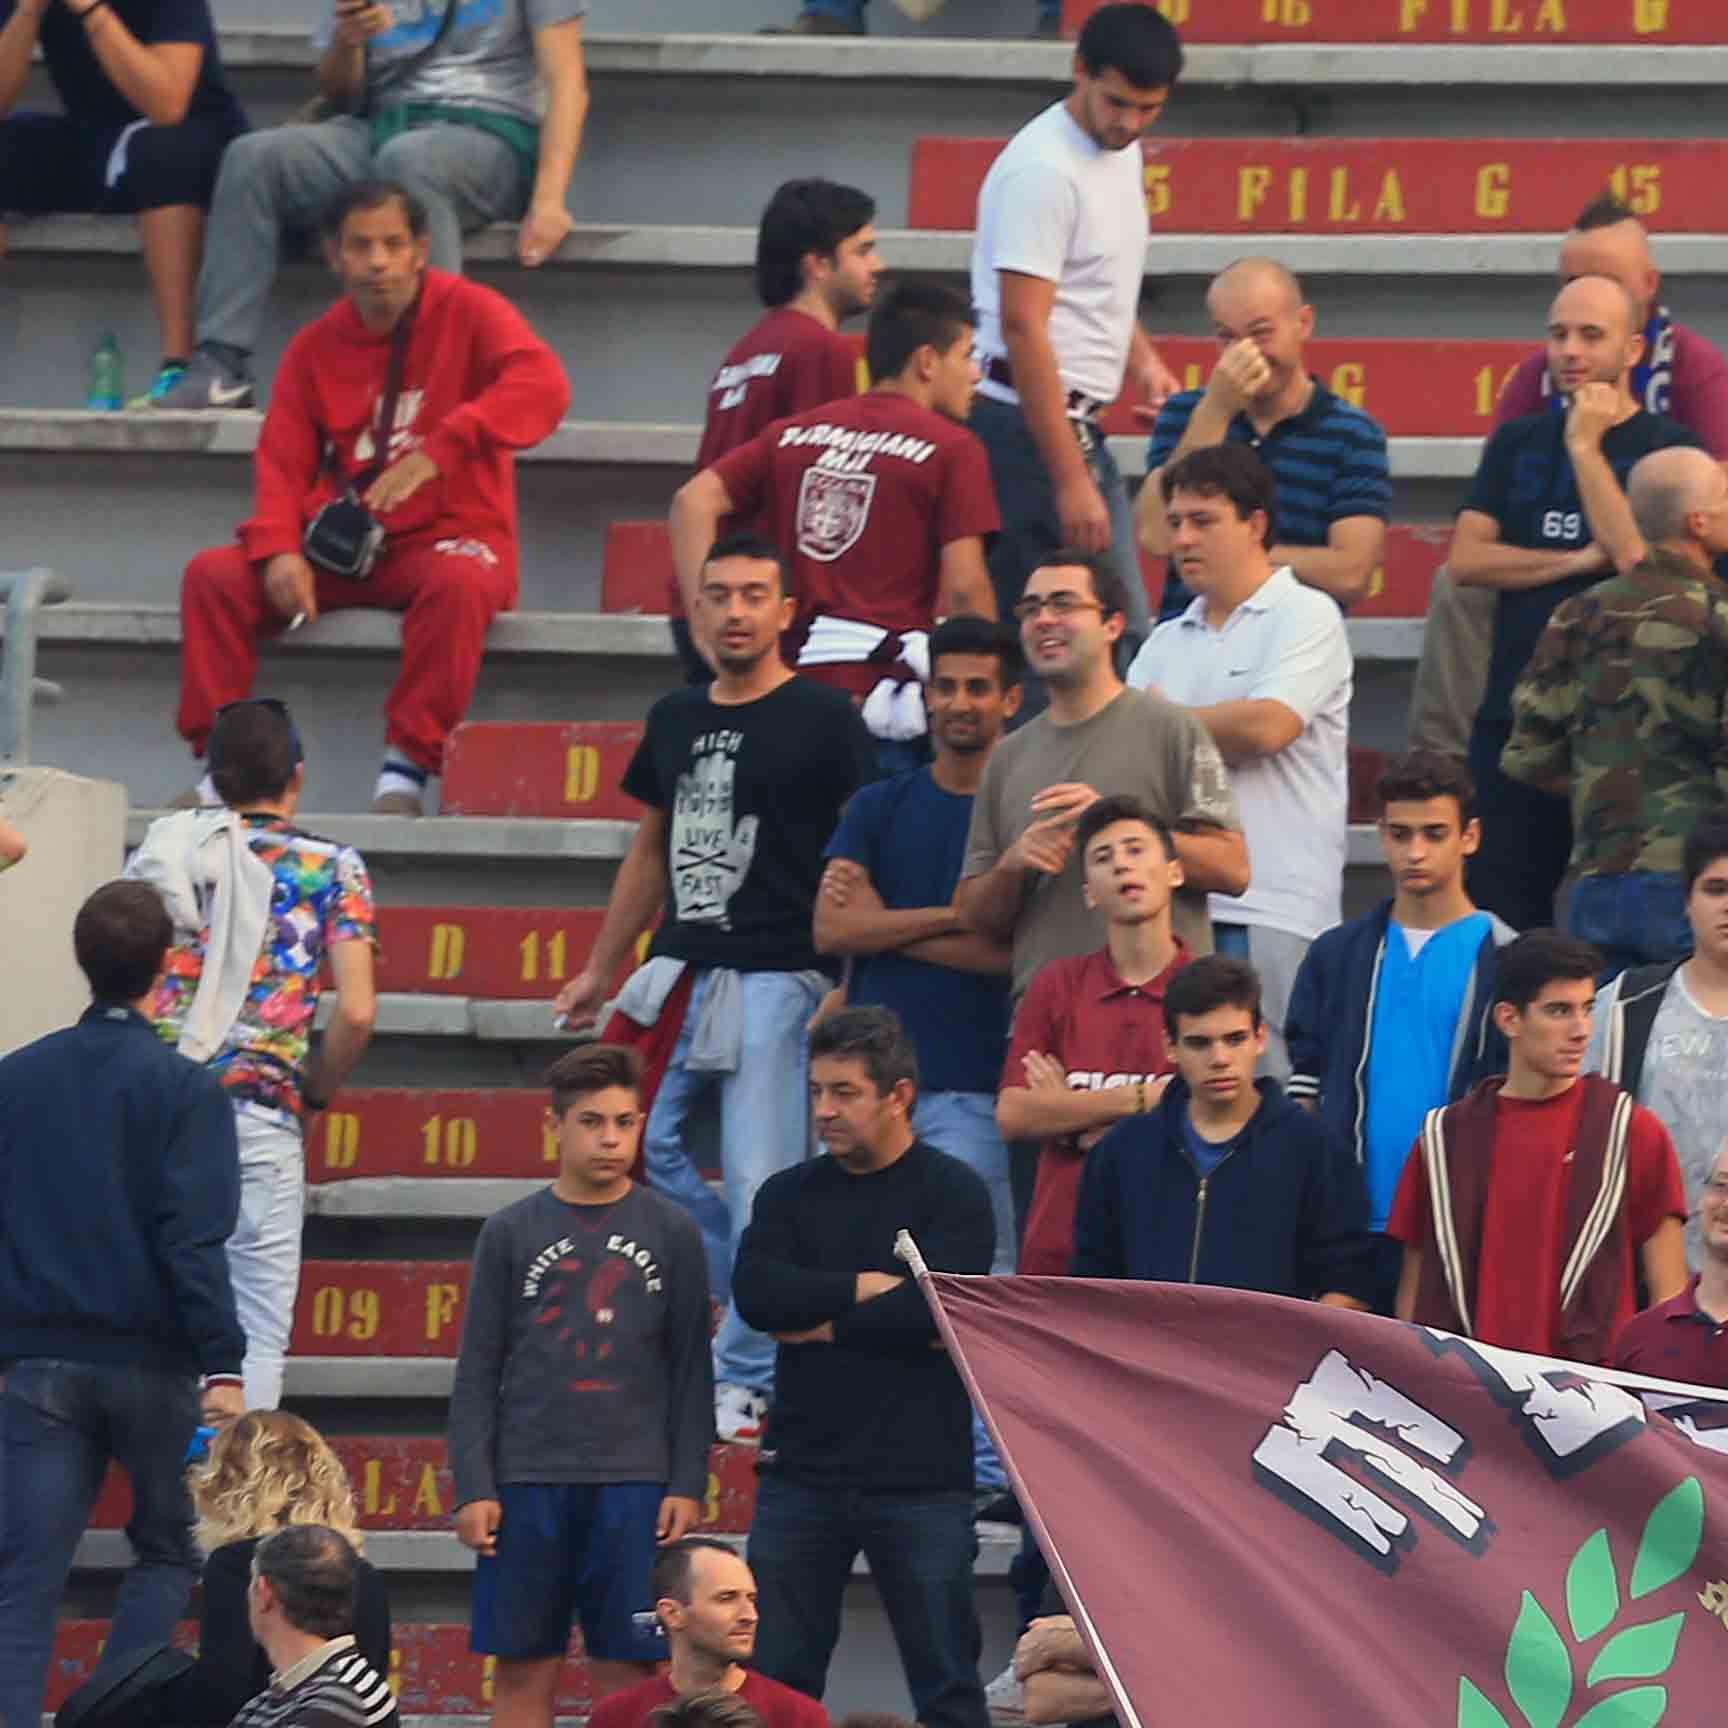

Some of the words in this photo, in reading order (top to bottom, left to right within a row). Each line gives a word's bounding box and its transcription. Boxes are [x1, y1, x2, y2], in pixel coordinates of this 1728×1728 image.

[1238, 165, 1406, 221] FILA
[1475, 164, 1509, 219] G
[1542, 509, 1579, 540] 69
[565, 745, 601, 802] D
[428, 923, 464, 979] D
[519, 929, 567, 981] 11
[324, 1112, 361, 1168] D
[420, 1114, 476, 1169] 10
[521, 1237, 576, 1298] WHITE
[606, 1234, 663, 1294] EAGLE
[312, 1286, 380, 1339] 09
[362, 1457, 445, 1517] LA
